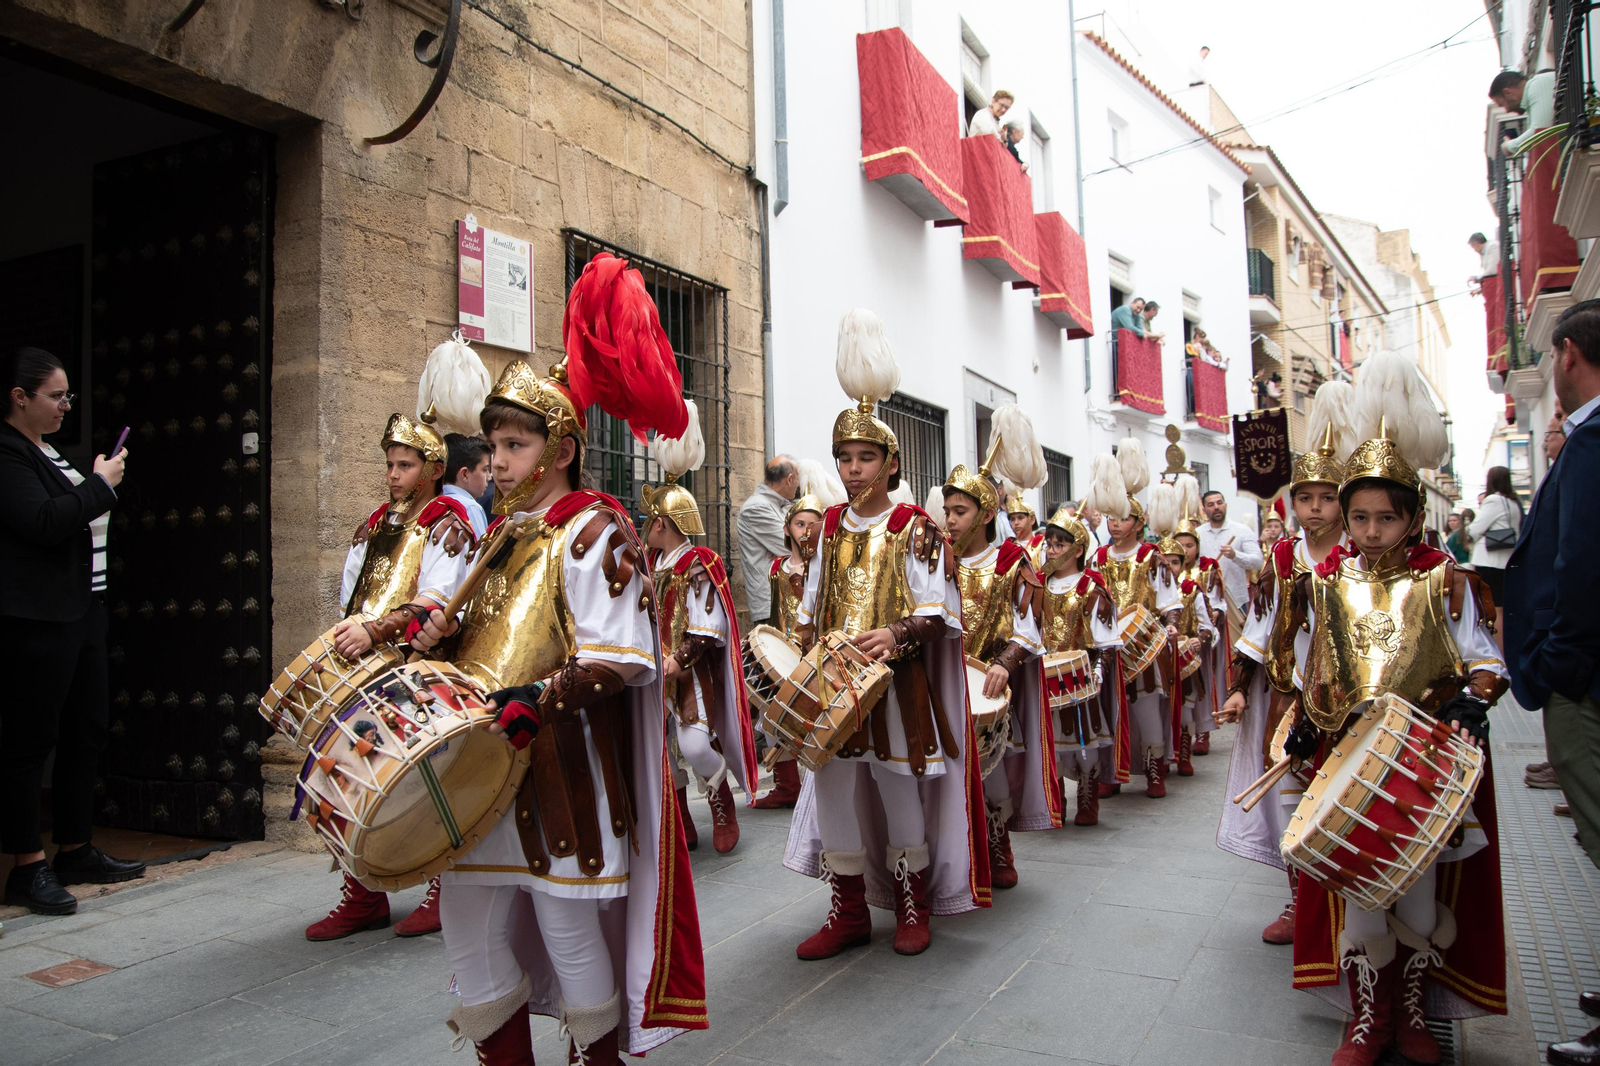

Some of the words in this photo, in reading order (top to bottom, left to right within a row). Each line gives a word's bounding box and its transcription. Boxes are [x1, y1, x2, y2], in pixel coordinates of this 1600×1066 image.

[464, 234, 473, 242] Ruta
[491, 237, 516, 251] Montilla
[461, 241, 481, 252] Califato
[1241, 423, 1277, 437] INFANTIL
[1244, 436, 1277, 452] SPQR
